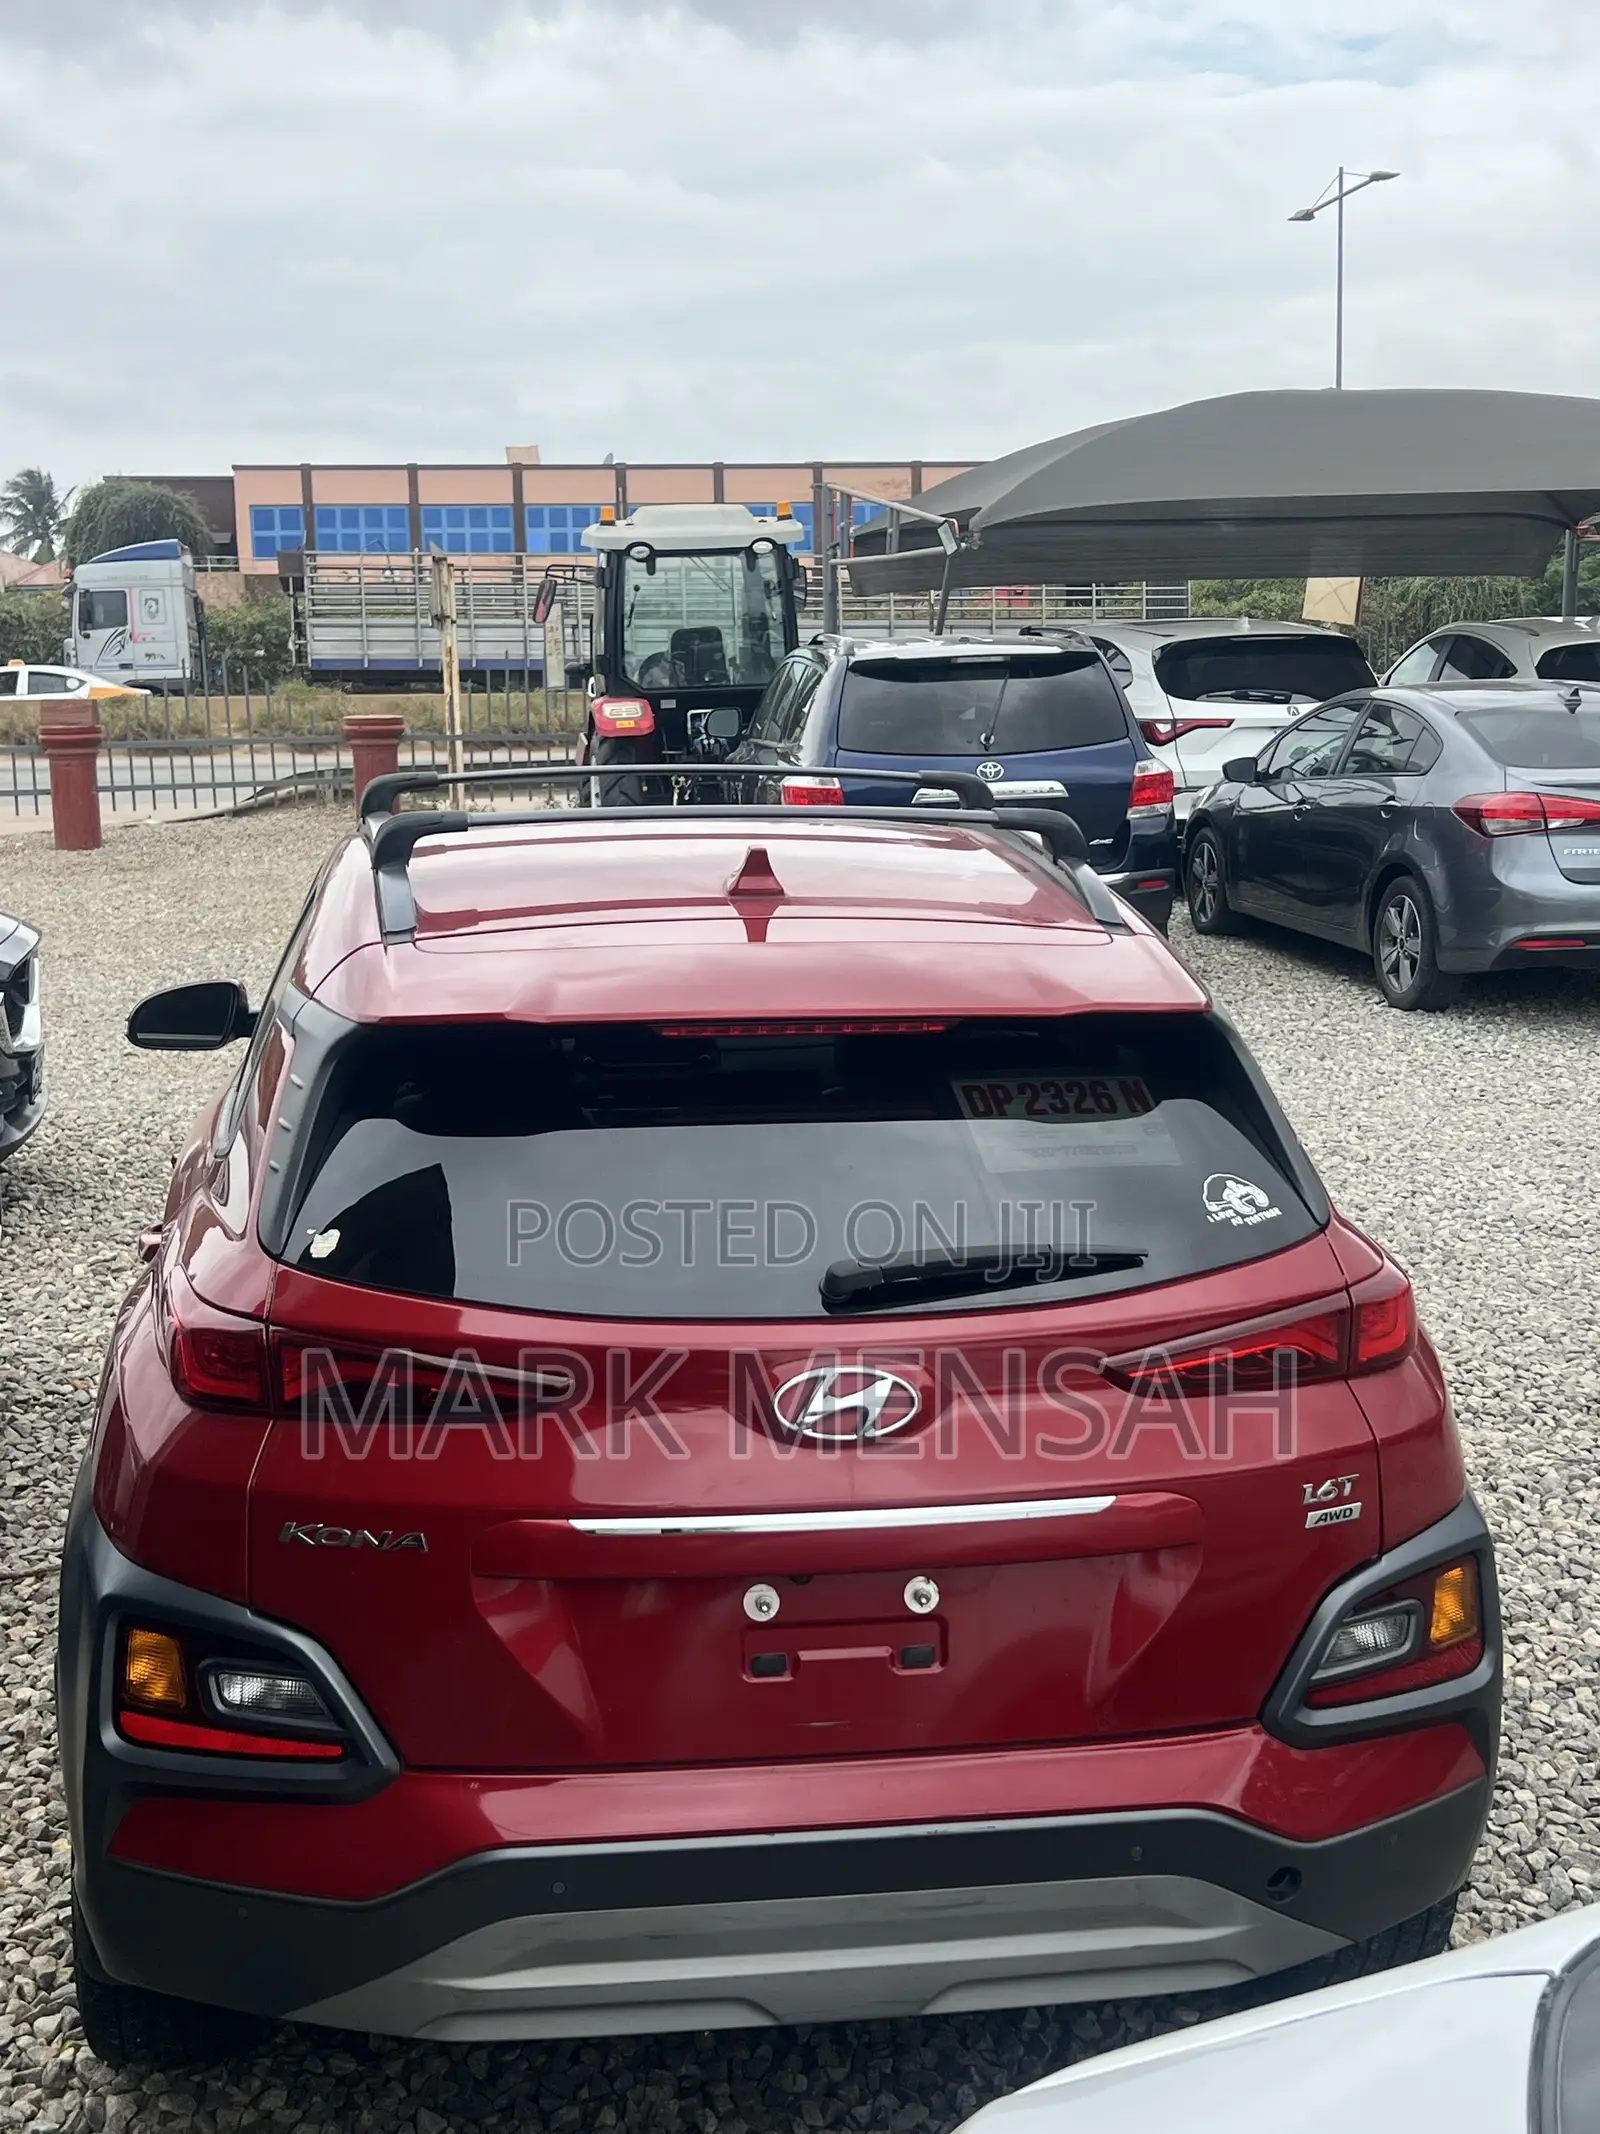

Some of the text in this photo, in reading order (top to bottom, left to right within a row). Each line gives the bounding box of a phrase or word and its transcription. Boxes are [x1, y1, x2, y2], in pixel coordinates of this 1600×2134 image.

[961, 1080, 1153, 1118] DP 2326 N
[1313, 1507, 1354, 1525] AWD
[278, 1521, 429, 1552] KONA
